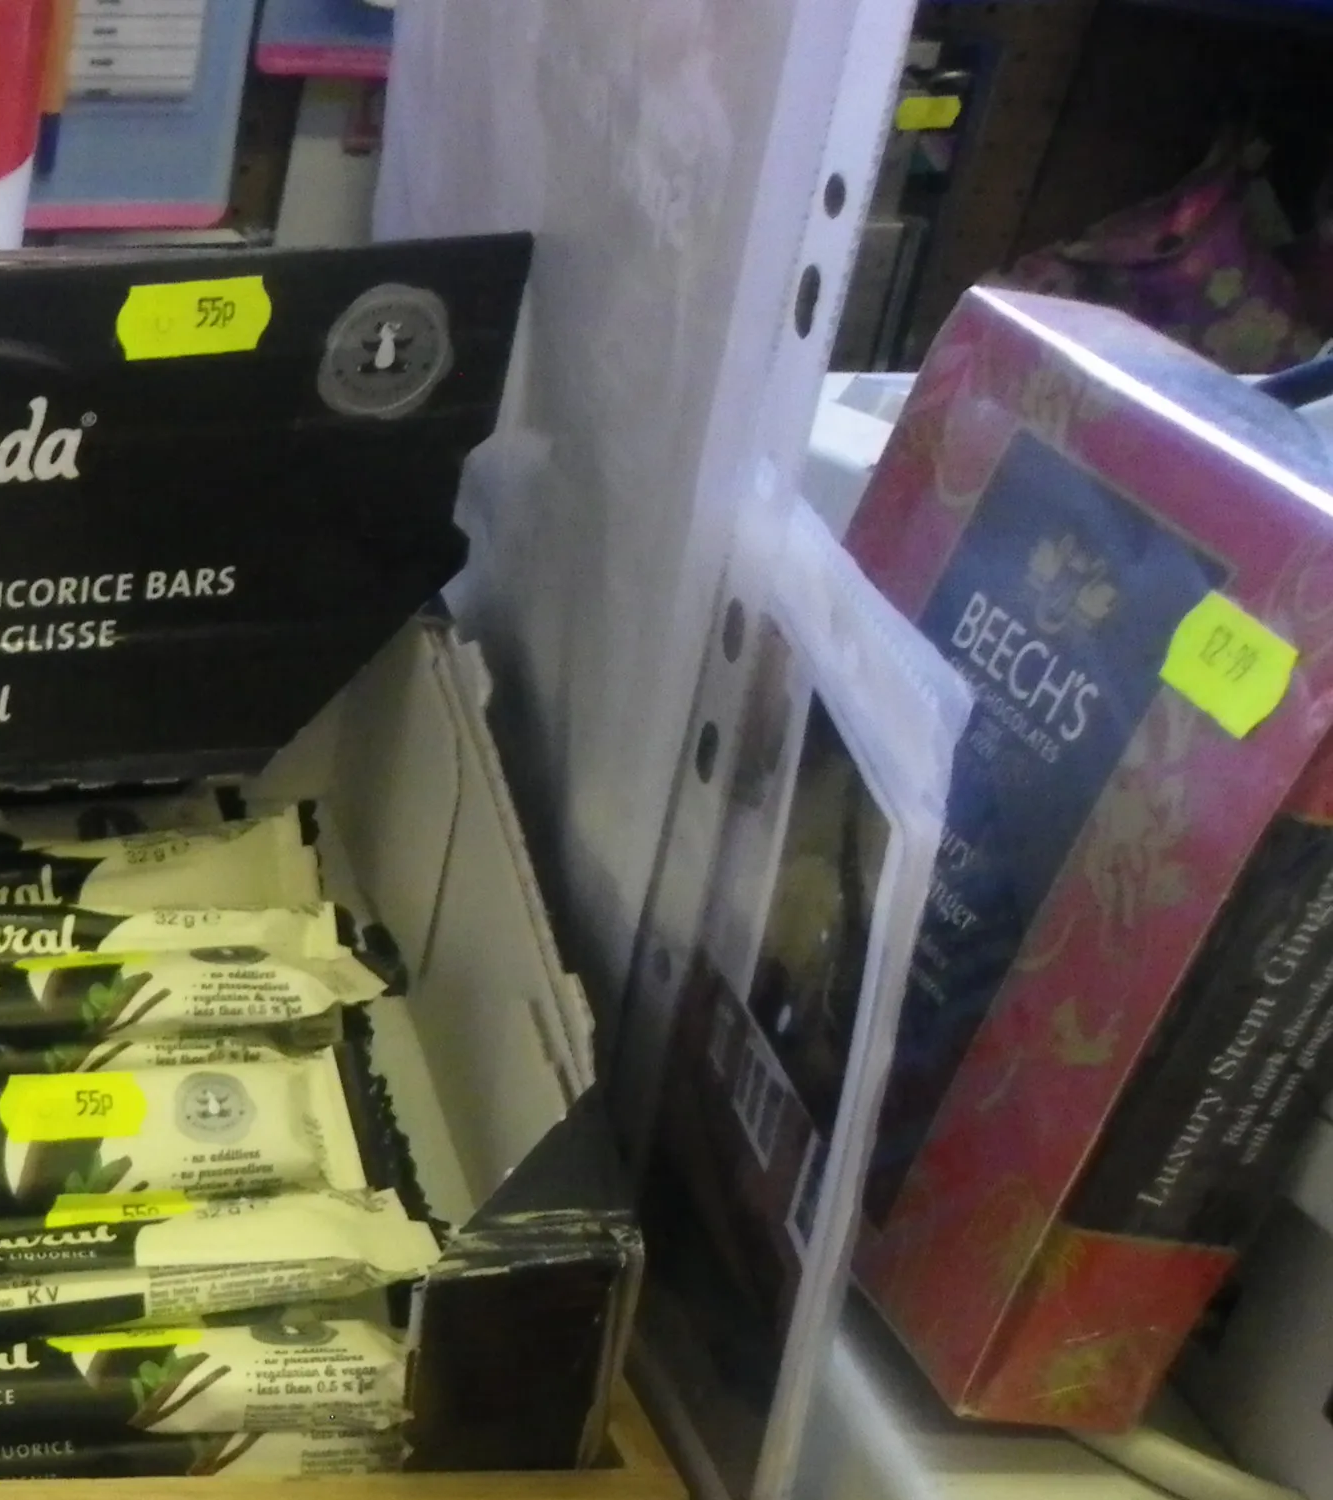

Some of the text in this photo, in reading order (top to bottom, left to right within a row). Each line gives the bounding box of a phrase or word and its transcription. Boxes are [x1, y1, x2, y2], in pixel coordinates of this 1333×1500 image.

[195, 294, 236, 331] 55p
[144, 565, 237, 602] BARS
[950, 591, 1100, 742] BEECH'S
[74, 1089, 115, 1119] 55p
[1135, 993, 1277, 1208] Luxury Stem
